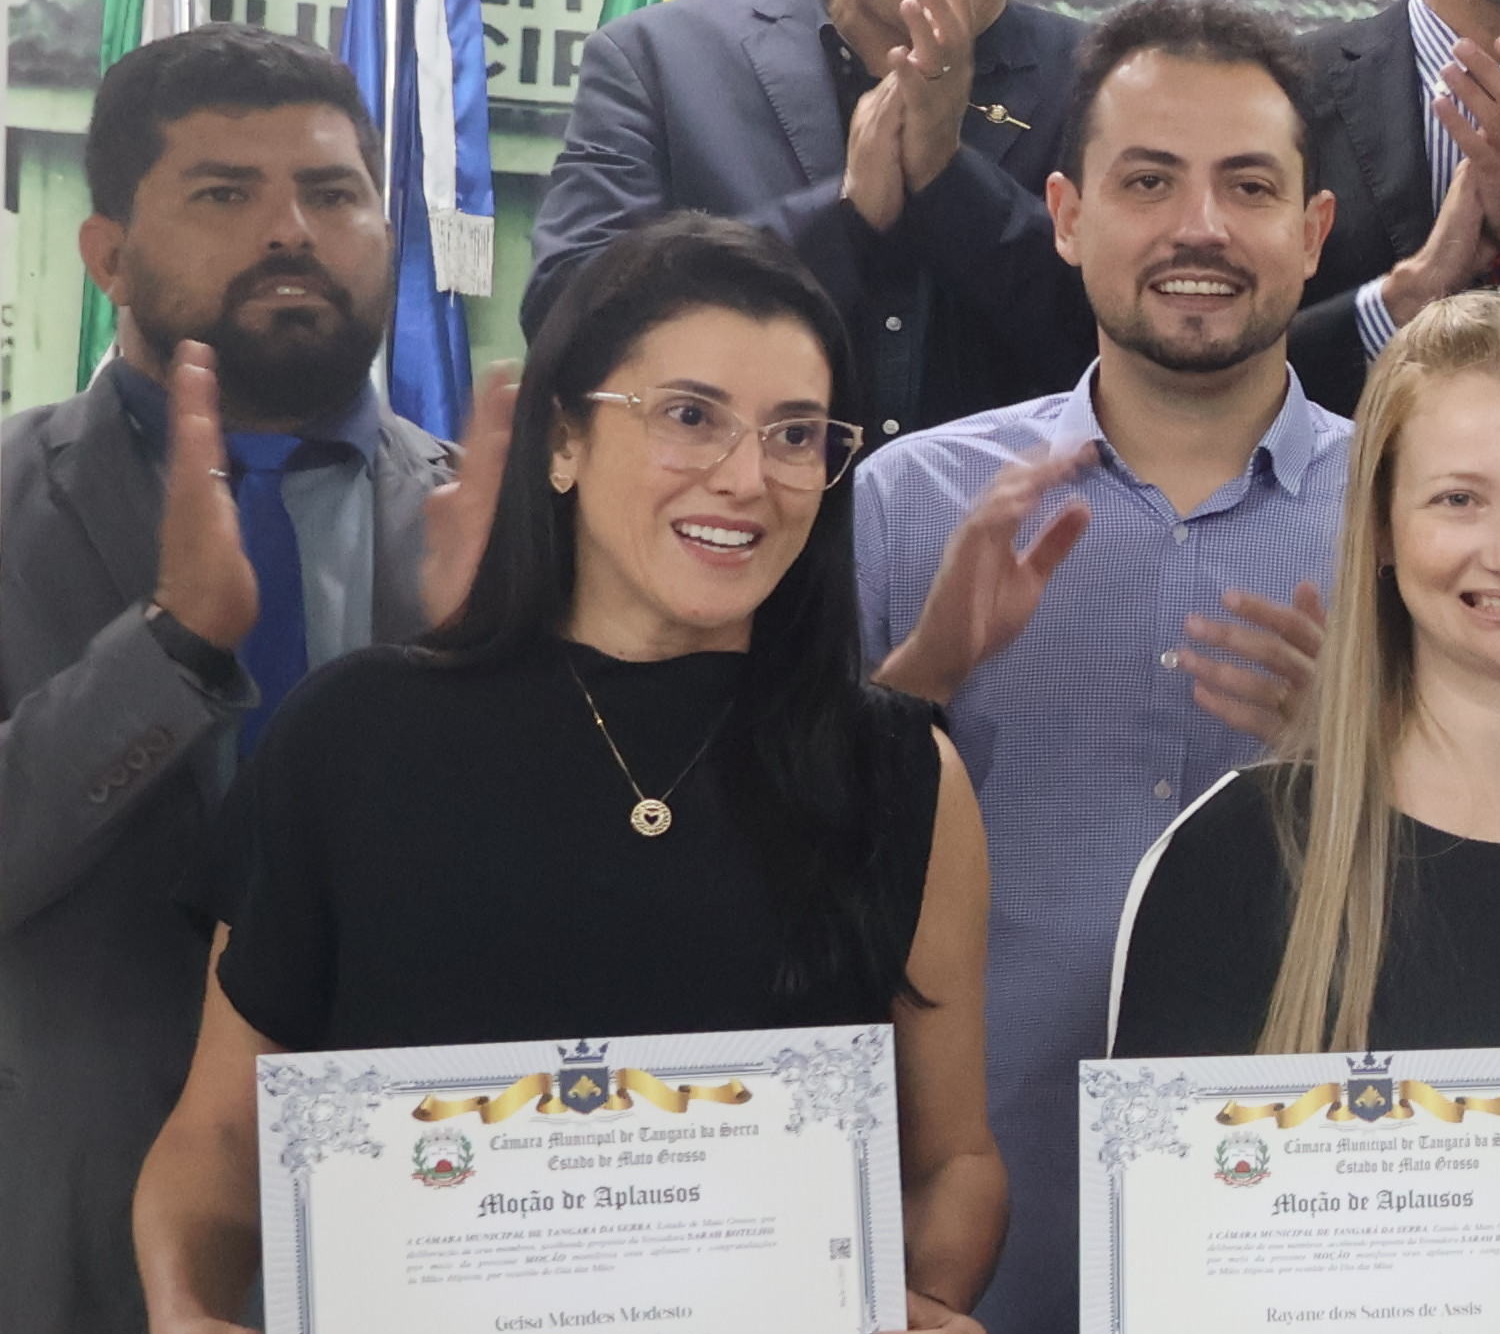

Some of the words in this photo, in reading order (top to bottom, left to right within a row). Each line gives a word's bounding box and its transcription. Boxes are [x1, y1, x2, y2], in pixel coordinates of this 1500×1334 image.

[477, 1189, 555, 1219] Moção
[561, 1189, 587, 1211] de
[593, 1184, 701, 1211] Aplausos
[1271, 1191, 1341, 1219] Moção
[1347, 1192, 1370, 1211] de
[1376, 1189, 1474, 1213] Aplausos
[494, 1315, 543, 1332] Geisa
[548, 1309, 616, 1328] Mendes
[619, 1305, 693, 1323] Modesto
[1266, 1307, 1325, 1326] Rayane
[1328, 1305, 1357, 1321] dos
[1360, 1305, 1415, 1319] Santos
[1418, 1302, 1437, 1318] de
[1444, 1301, 1482, 1316] Assis
